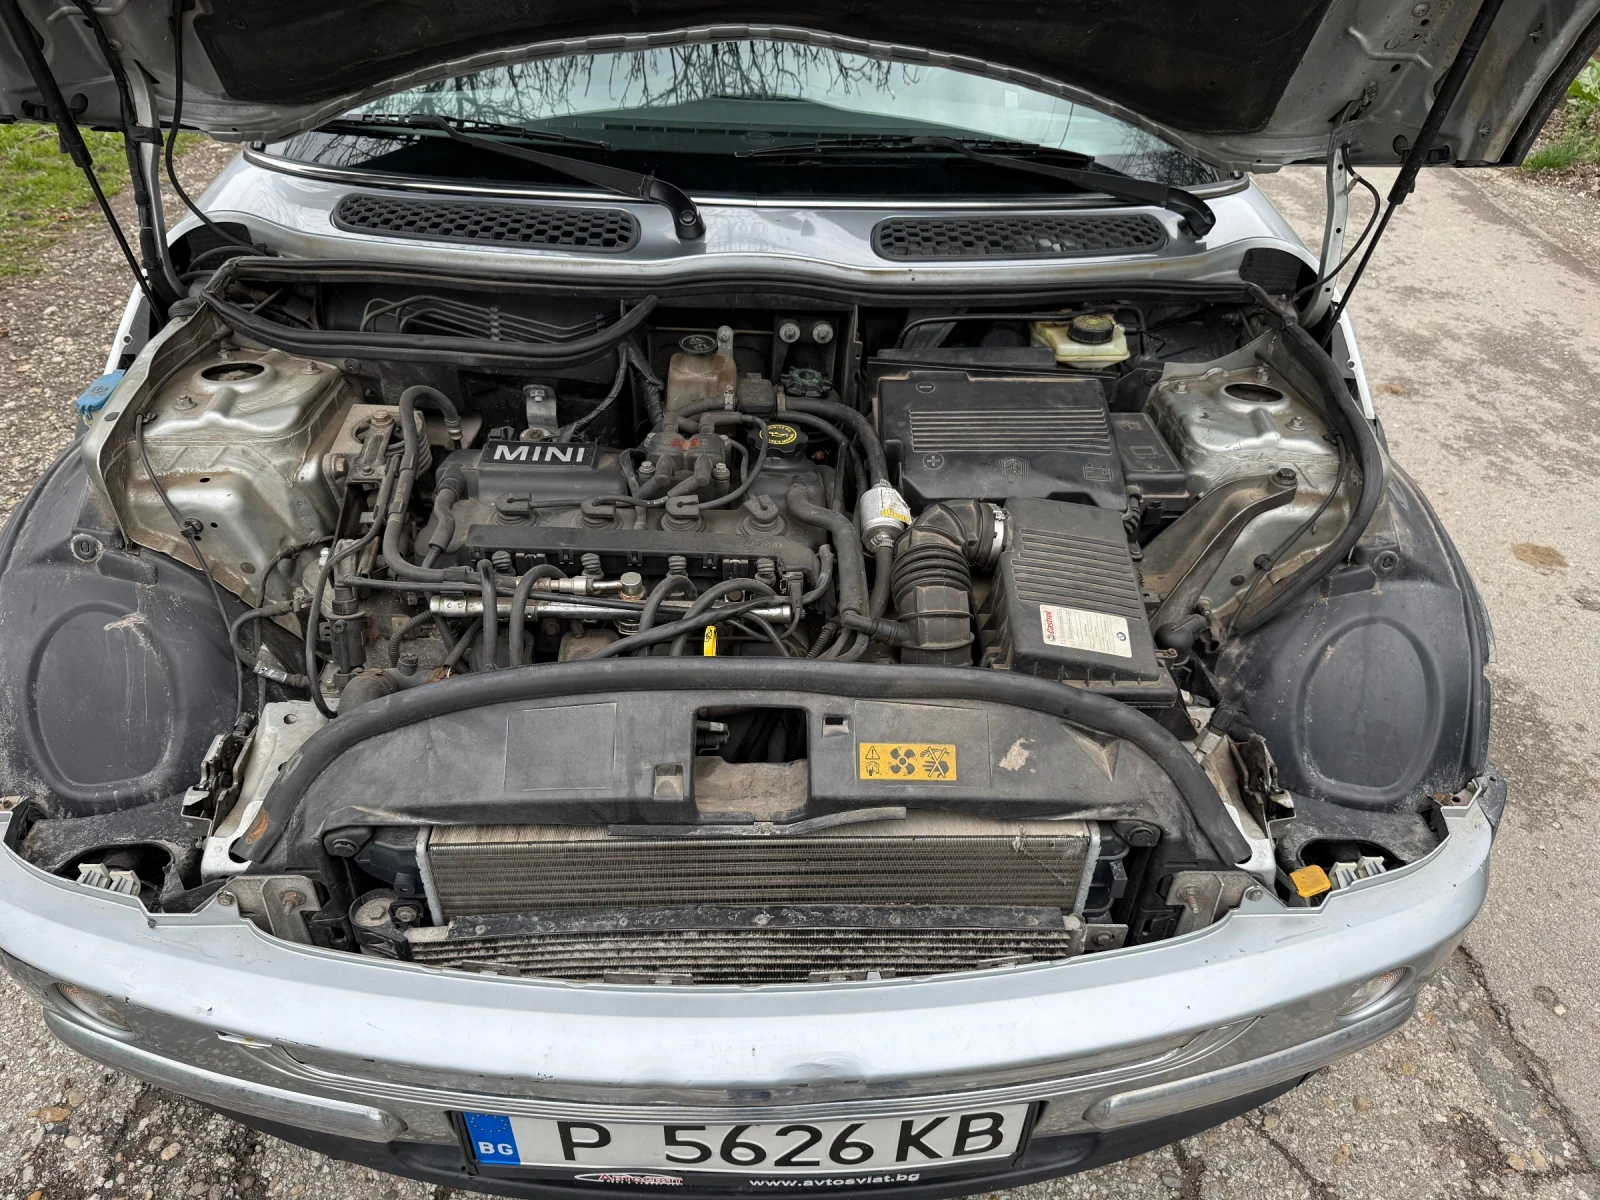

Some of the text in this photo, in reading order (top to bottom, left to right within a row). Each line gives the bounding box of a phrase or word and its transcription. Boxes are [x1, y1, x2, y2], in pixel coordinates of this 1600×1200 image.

[493, 445, 585, 462] MINI
[478, 1111, 1005, 1166] BG P 5626 KB
[749, 1173, 920, 1187] www.avtosviat.bg
